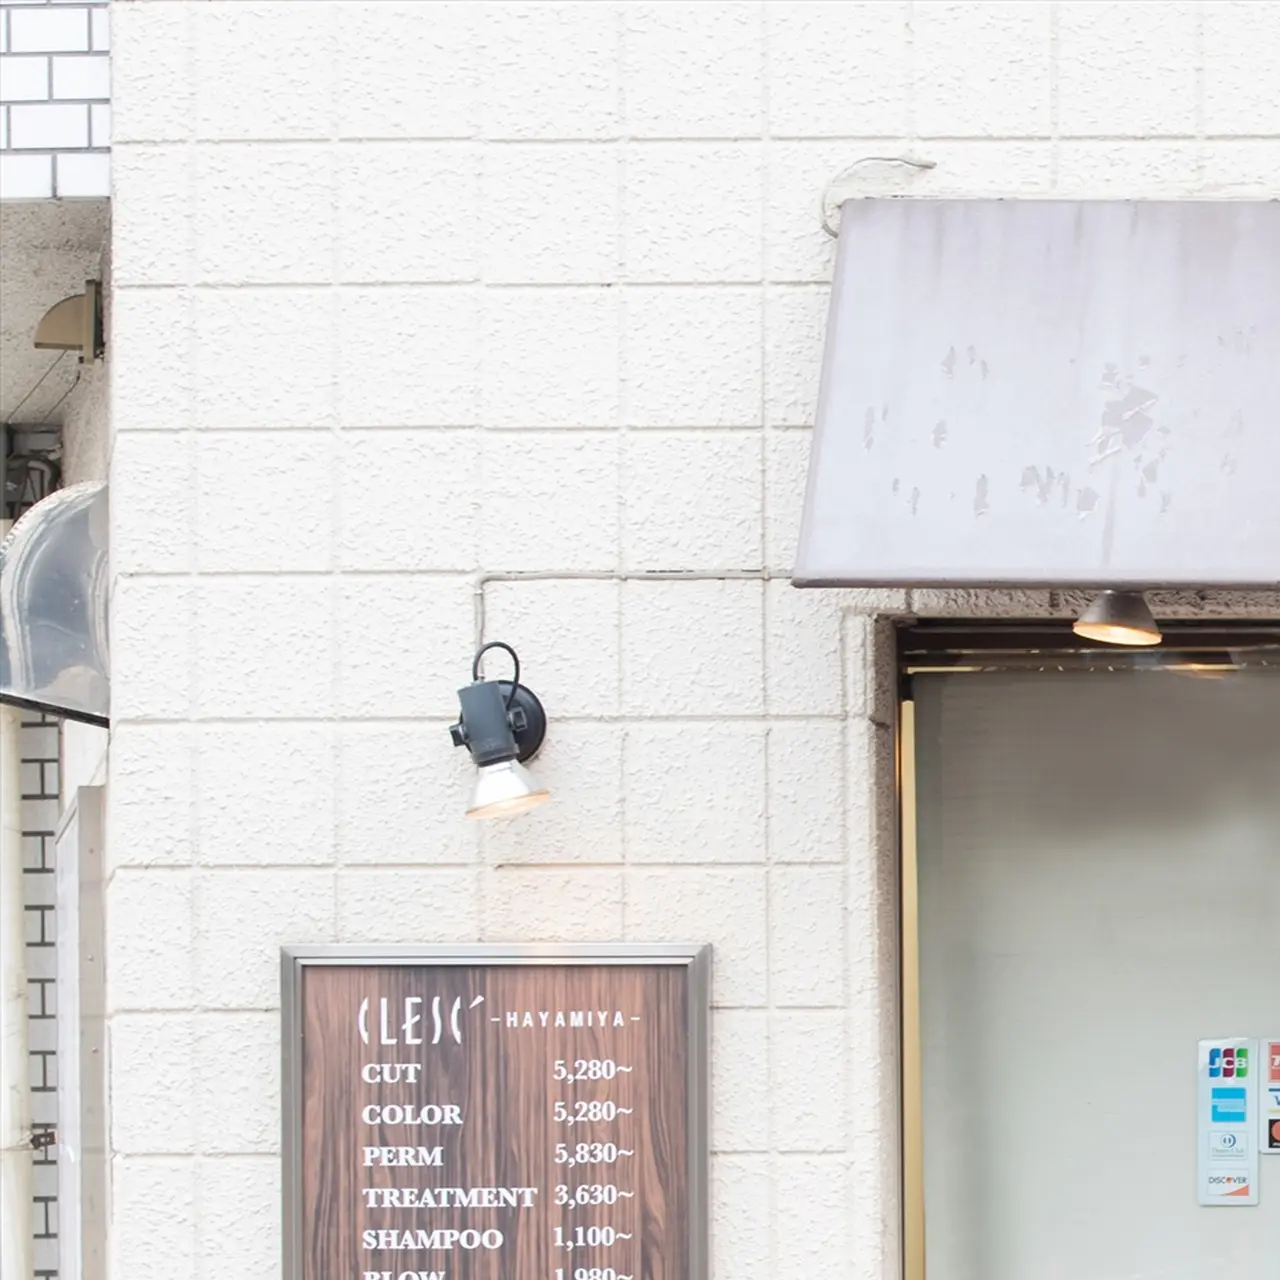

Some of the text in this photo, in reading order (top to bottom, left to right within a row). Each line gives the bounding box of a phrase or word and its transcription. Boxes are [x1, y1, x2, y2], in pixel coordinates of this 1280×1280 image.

[361, 1059, 632, 1084] CUT 5,280~
[1209, 1053, 1247, 1074] JCB
[361, 1101, 633, 1126] COLOR 5,280~
[362, 1143, 634, 1168] PERM 5,830~
[1208, 1176, 1247, 1184] DISCOVER
[362, 1184, 634, 1210] TREATMENT 3,630~
[362, 1226, 632, 1251] SHAMPOO 1,100~
